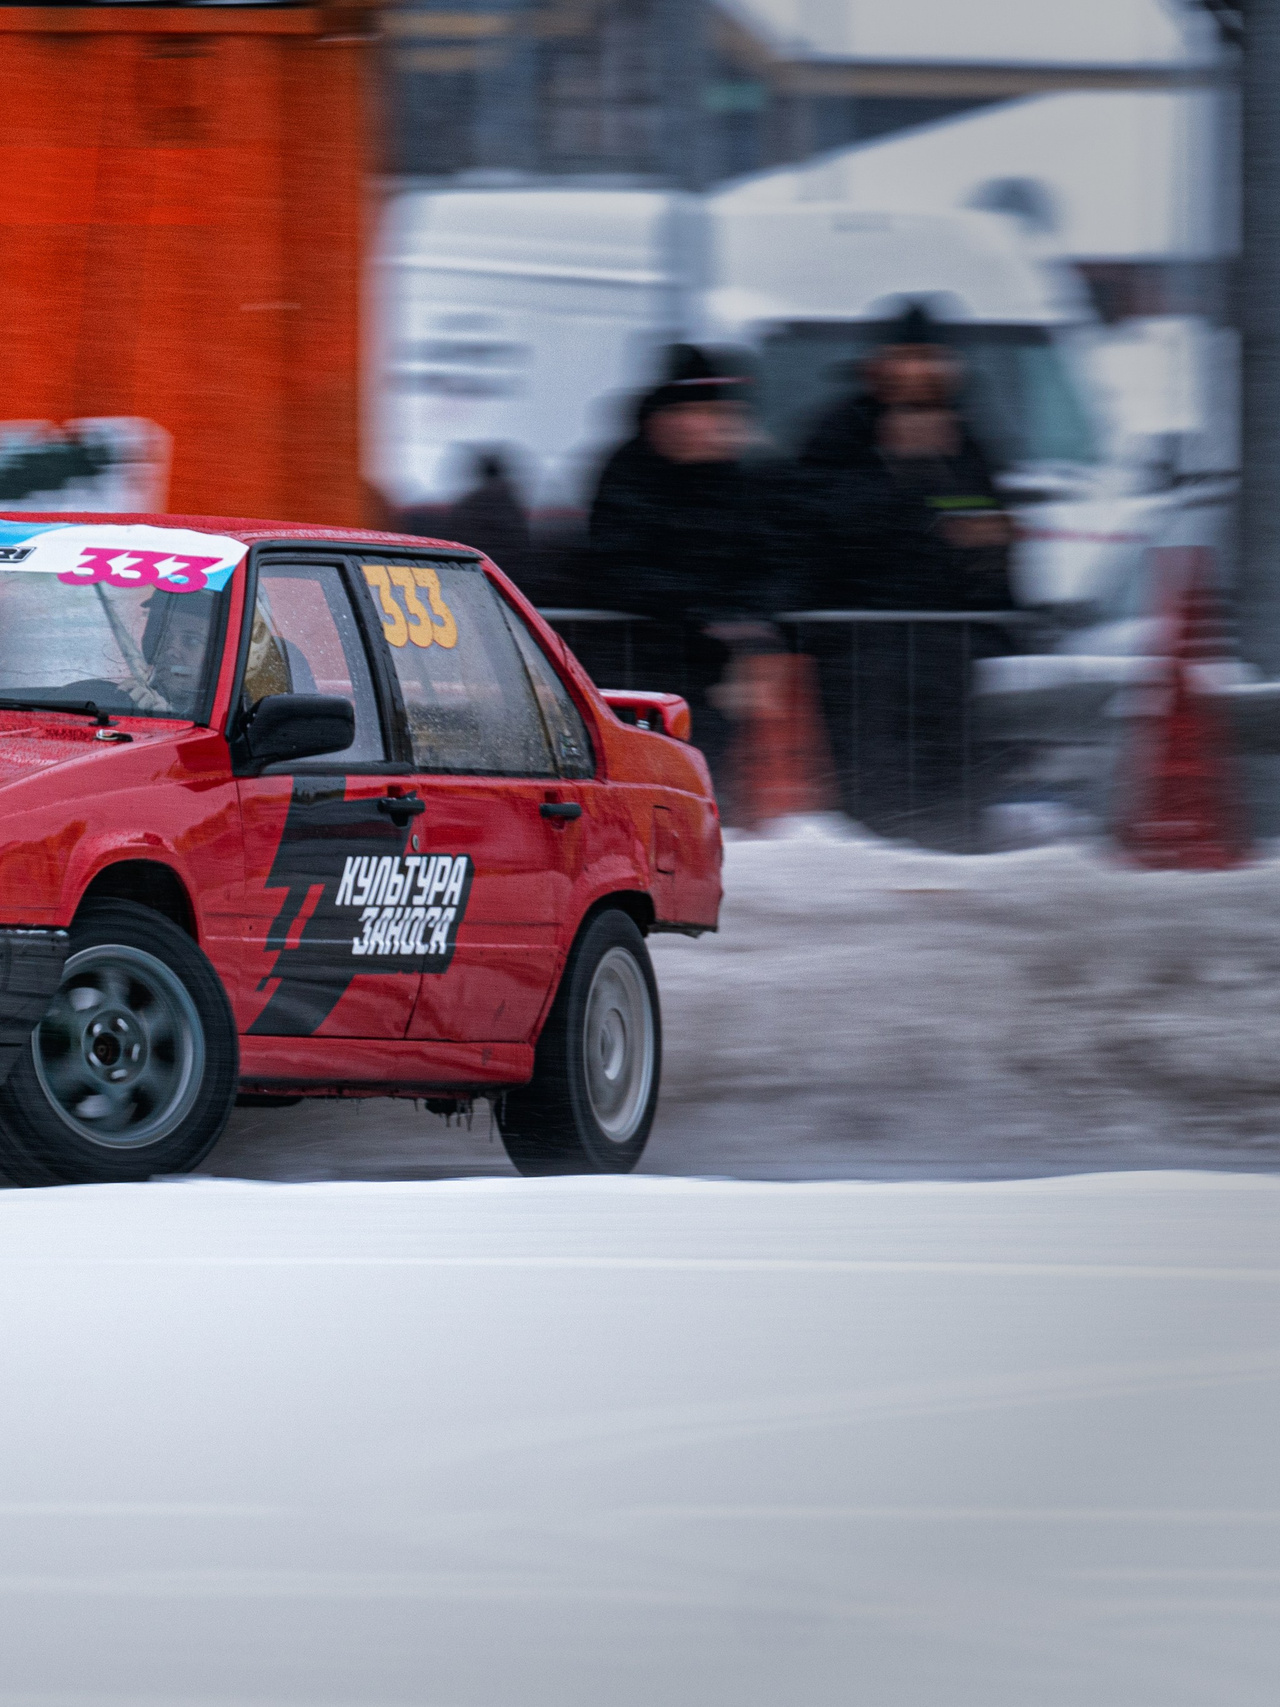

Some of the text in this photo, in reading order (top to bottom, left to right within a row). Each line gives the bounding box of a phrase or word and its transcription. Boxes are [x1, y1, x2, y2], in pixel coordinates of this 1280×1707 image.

[57, 547, 223, 594] 333
[361, 565, 458, 649] 333
[335, 856, 468, 906] КУЛЬТУРА
[351, 907, 456, 955] ЗАНОСА
